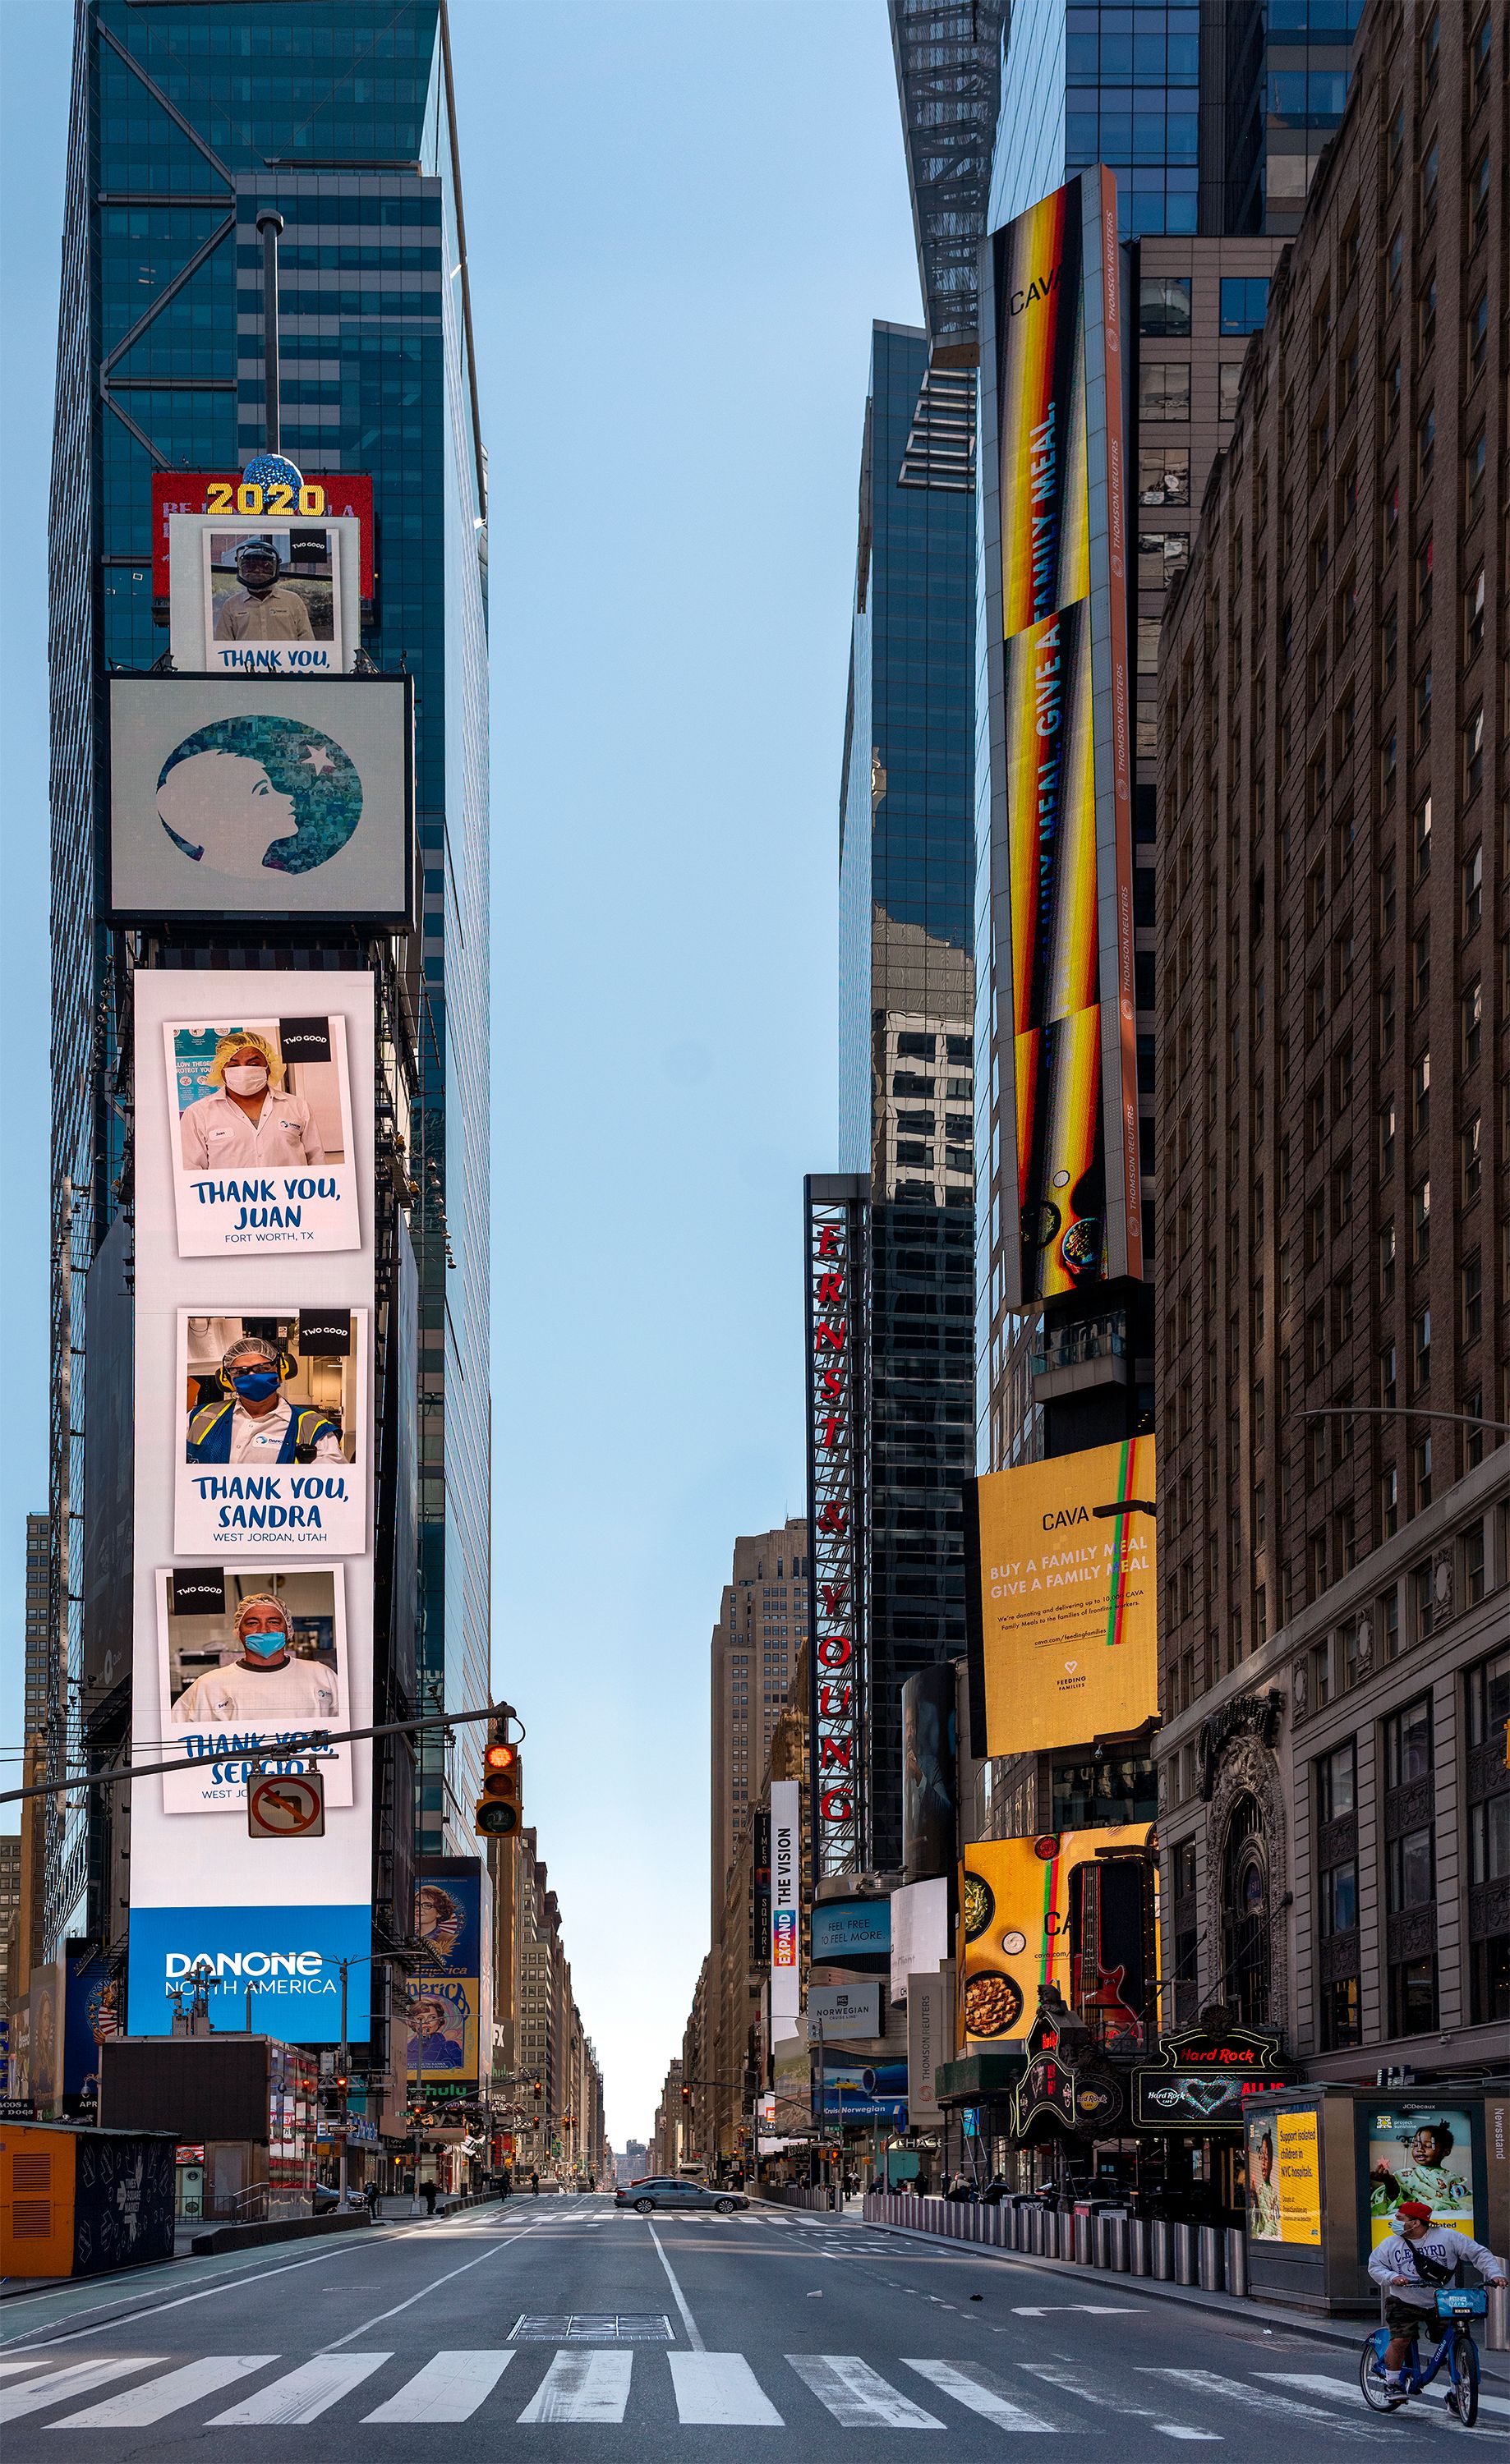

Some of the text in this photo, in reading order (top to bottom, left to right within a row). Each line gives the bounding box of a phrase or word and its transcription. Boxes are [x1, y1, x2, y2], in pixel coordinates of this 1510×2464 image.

[1010, 262, 1062, 316] CAV
[207, 483, 325, 516] 2020
[1112, 494, 1121, 549] THOMSON
[1029, 402, 1062, 737] GIVE A FAMILY MEAL.
[218, 650, 330, 669] THANK YOU,
[1121, 885, 1130, 992] THOMSON REUTERS
[283, 1034, 327, 1045] TWO GOOD
[190, 1177, 342, 1205] THANK YOU,
[1127, 1157, 1136, 1211] THOMSON
[234, 1205, 302, 1230] JUAN
[225, 1232, 315, 1243] FORT WORTH, TX
[302, 1326, 348, 1336] TWO GOOD
[191, 1476, 349, 1502] THANK YOU,
[218, 1505, 322, 1529] SANDRA
[815, 1225, 853, 1822] ERNST & YOUNG
[1043, 1506, 1090, 1531] CAVA
[213, 1533, 327, 1542] WEST JORDAN, UTAH
[990, 1536, 1148, 1580] BUY A FAMILY MEAL
[991, 1556, 1149, 1599] GIVE A FAMILY MEAL
[177, 1586, 223, 1596] TWO GOOD
[1015, 1609, 1042, 1620] donating
[1043, 1606, 1054, 1614] and
[1055, 1602, 1084, 1612] delivering
[1126, 1589, 1144, 1598] CAVA
[1001, 1621, 1020, 1631] Family
[1021, 1619, 1038, 1627] Meals
[1057, 1611, 1080, 1621] families
[1089, 1605, 1112, 1615] frontline
[1034, 1628, 1107, 1646] cava.com/feedingfamilies
[1057, 1676, 1087, 1685] FEEDING
[1059, 1683, 1085, 1691] FAMILIES
[178, 1730, 334, 1758] THANK YOU,
[202, 1789, 232, 1799] WEST
[778, 1827, 791, 1965] EXPAND THE VISION
[828, 1919, 870, 1931] FEEL FREE
[821, 1930, 886, 1945] TO FEEL MORE.
[166, 1951, 323, 1978] DANONE
[166, 1979, 337, 1996] NORTH AMERICA
[817, 2006, 869, 2016] NORWEGIAN
[922, 1995, 930, 2080] THOMSON REUTERS
[1181, 2048, 1254, 2064] Hard Rock
[426, 2084, 467, 2096] hulu
[1089, 2094, 1107, 2103] Rock
[1148, 2091, 1186, 2100] Hard Rock
[1279, 2127, 1316, 2144] Support isolated
[1494, 2108, 1507, 2159] Newsstand
[1281, 2147, 1304, 2159] children in
[1282, 2165, 1291, 2177] NYC
[1417, 2244, 1446, 2258] BYRD
